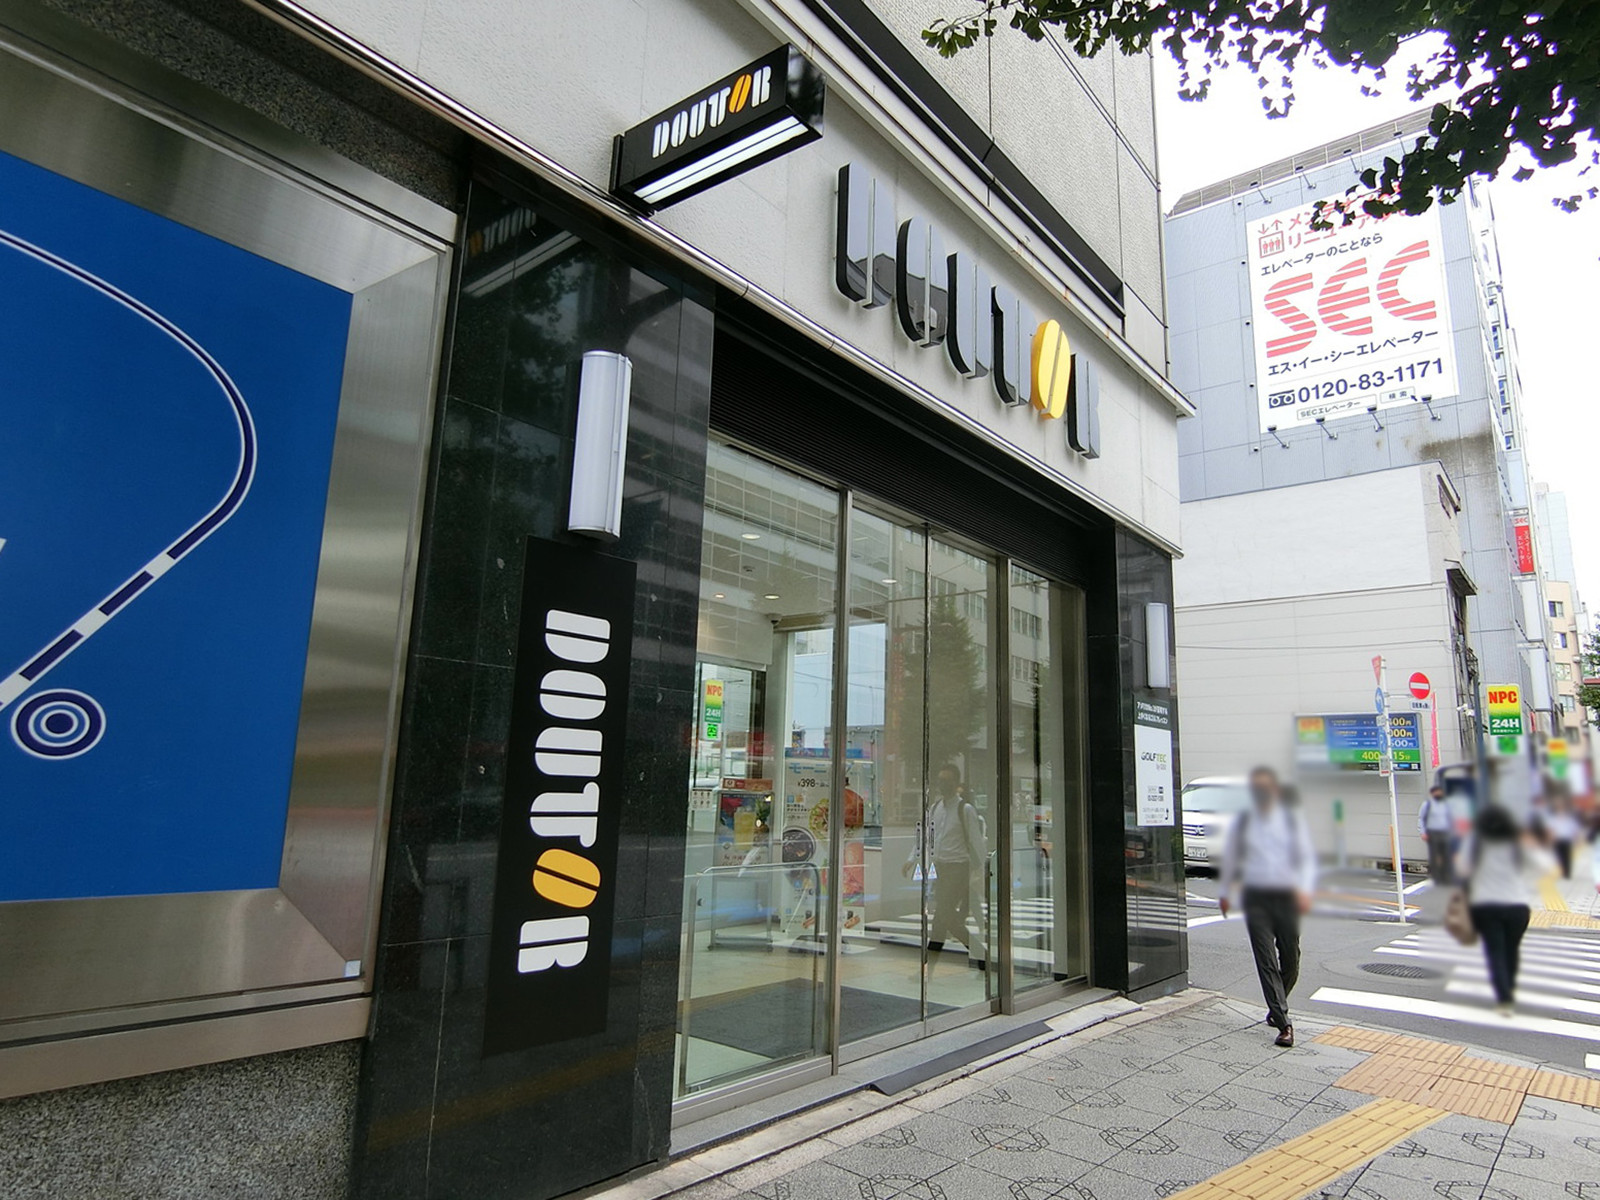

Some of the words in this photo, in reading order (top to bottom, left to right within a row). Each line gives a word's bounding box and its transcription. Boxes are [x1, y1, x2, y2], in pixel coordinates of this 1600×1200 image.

[652, 65, 773, 159] DOUTOR
[1261, 233, 1384, 276] エレベーターのことなら
[835, 161, 1101, 459] DOUTOR
[1263, 240, 1437, 359] SEC
[1268, 332, 1439, 377] エス・イー・シーエレベーター
[1298, 358, 1444, 404] 0120-83-1171
[1300, 400, 1361, 418] SECエレベーター
[706, 684, 723, 697] NPC
[706, 708, 721, 717] 24H
[1488, 691, 1518, 704] NPC
[1491, 718, 1520, 728] 24H
[517, 608, 611, 976] DOUTOR
